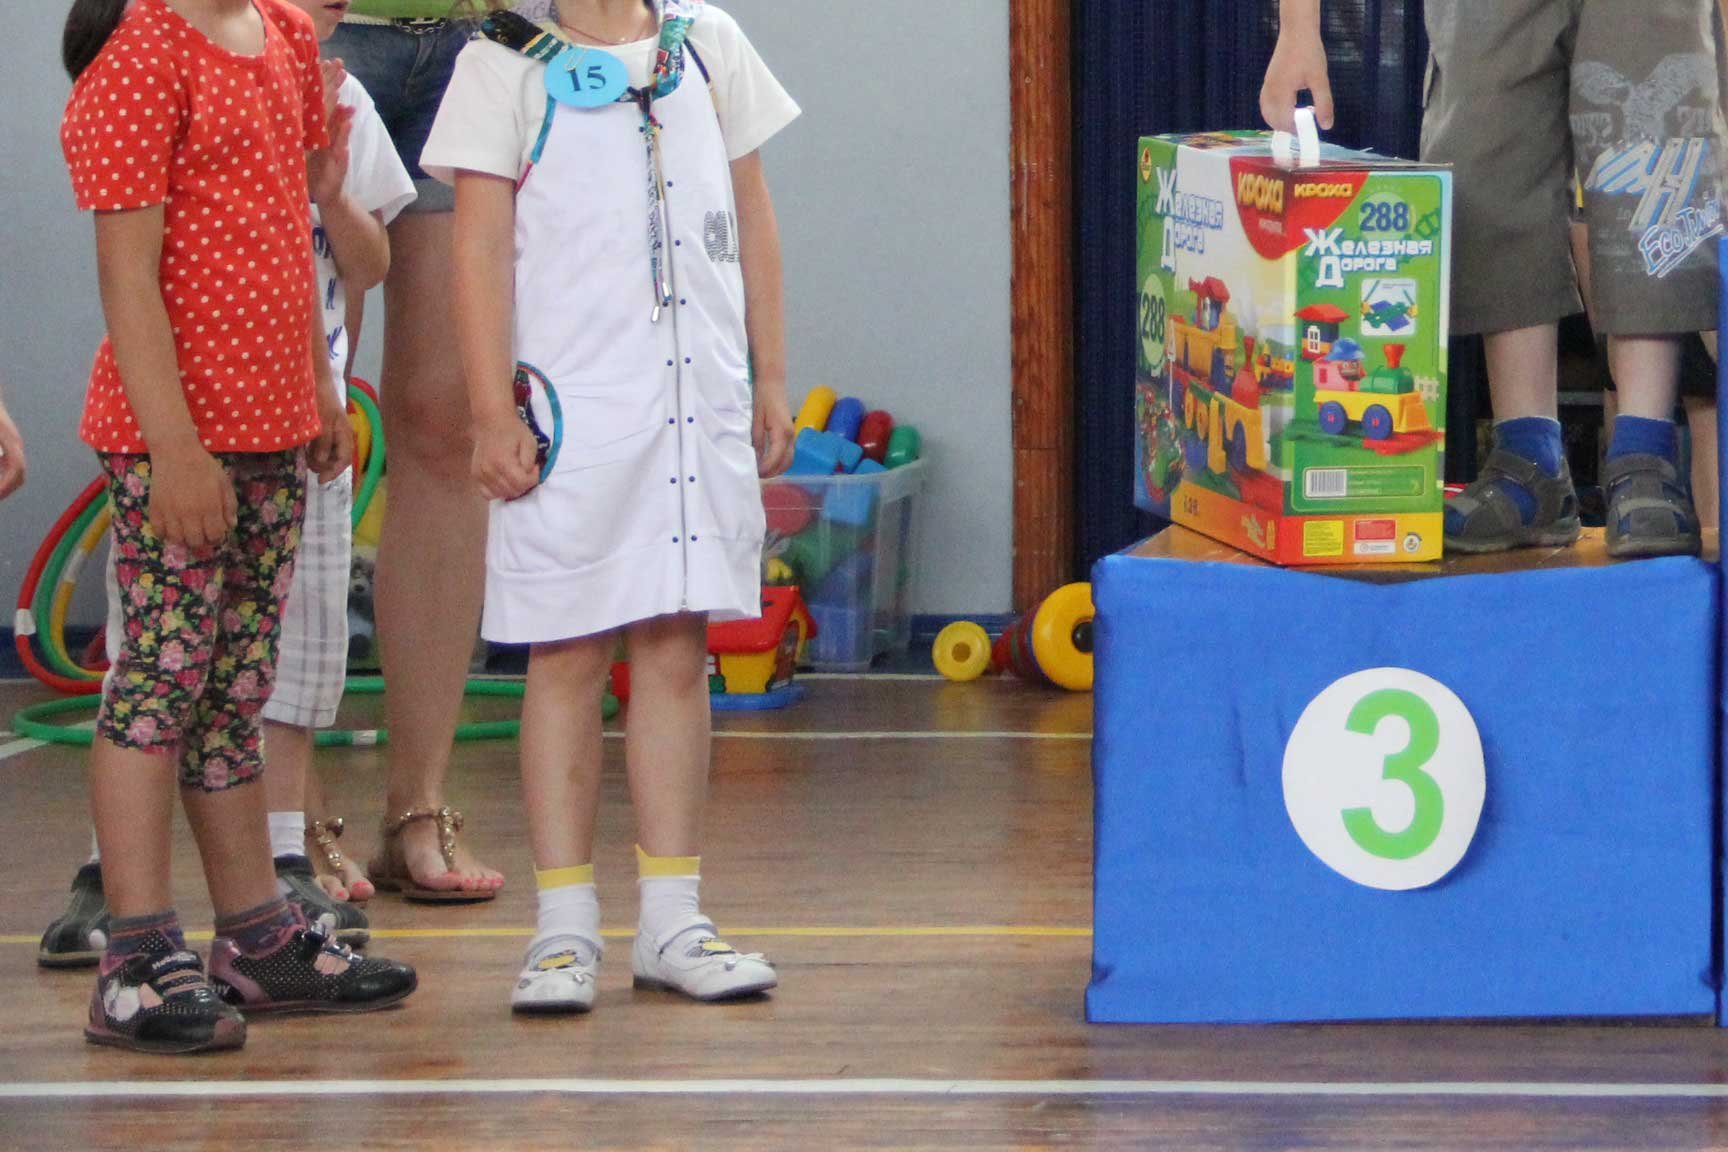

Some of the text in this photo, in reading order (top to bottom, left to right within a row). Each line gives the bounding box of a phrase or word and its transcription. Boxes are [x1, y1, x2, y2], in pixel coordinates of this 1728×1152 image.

[566, 65, 607, 92] 15
[1360, 201, 1409, 232] 288
[1303, 227, 1433, 257] Железная
[1315, 255, 1398, 288] Дорога
[1140, 292, 1166, 344] 288
[1343, 689, 1443, 859] 3
